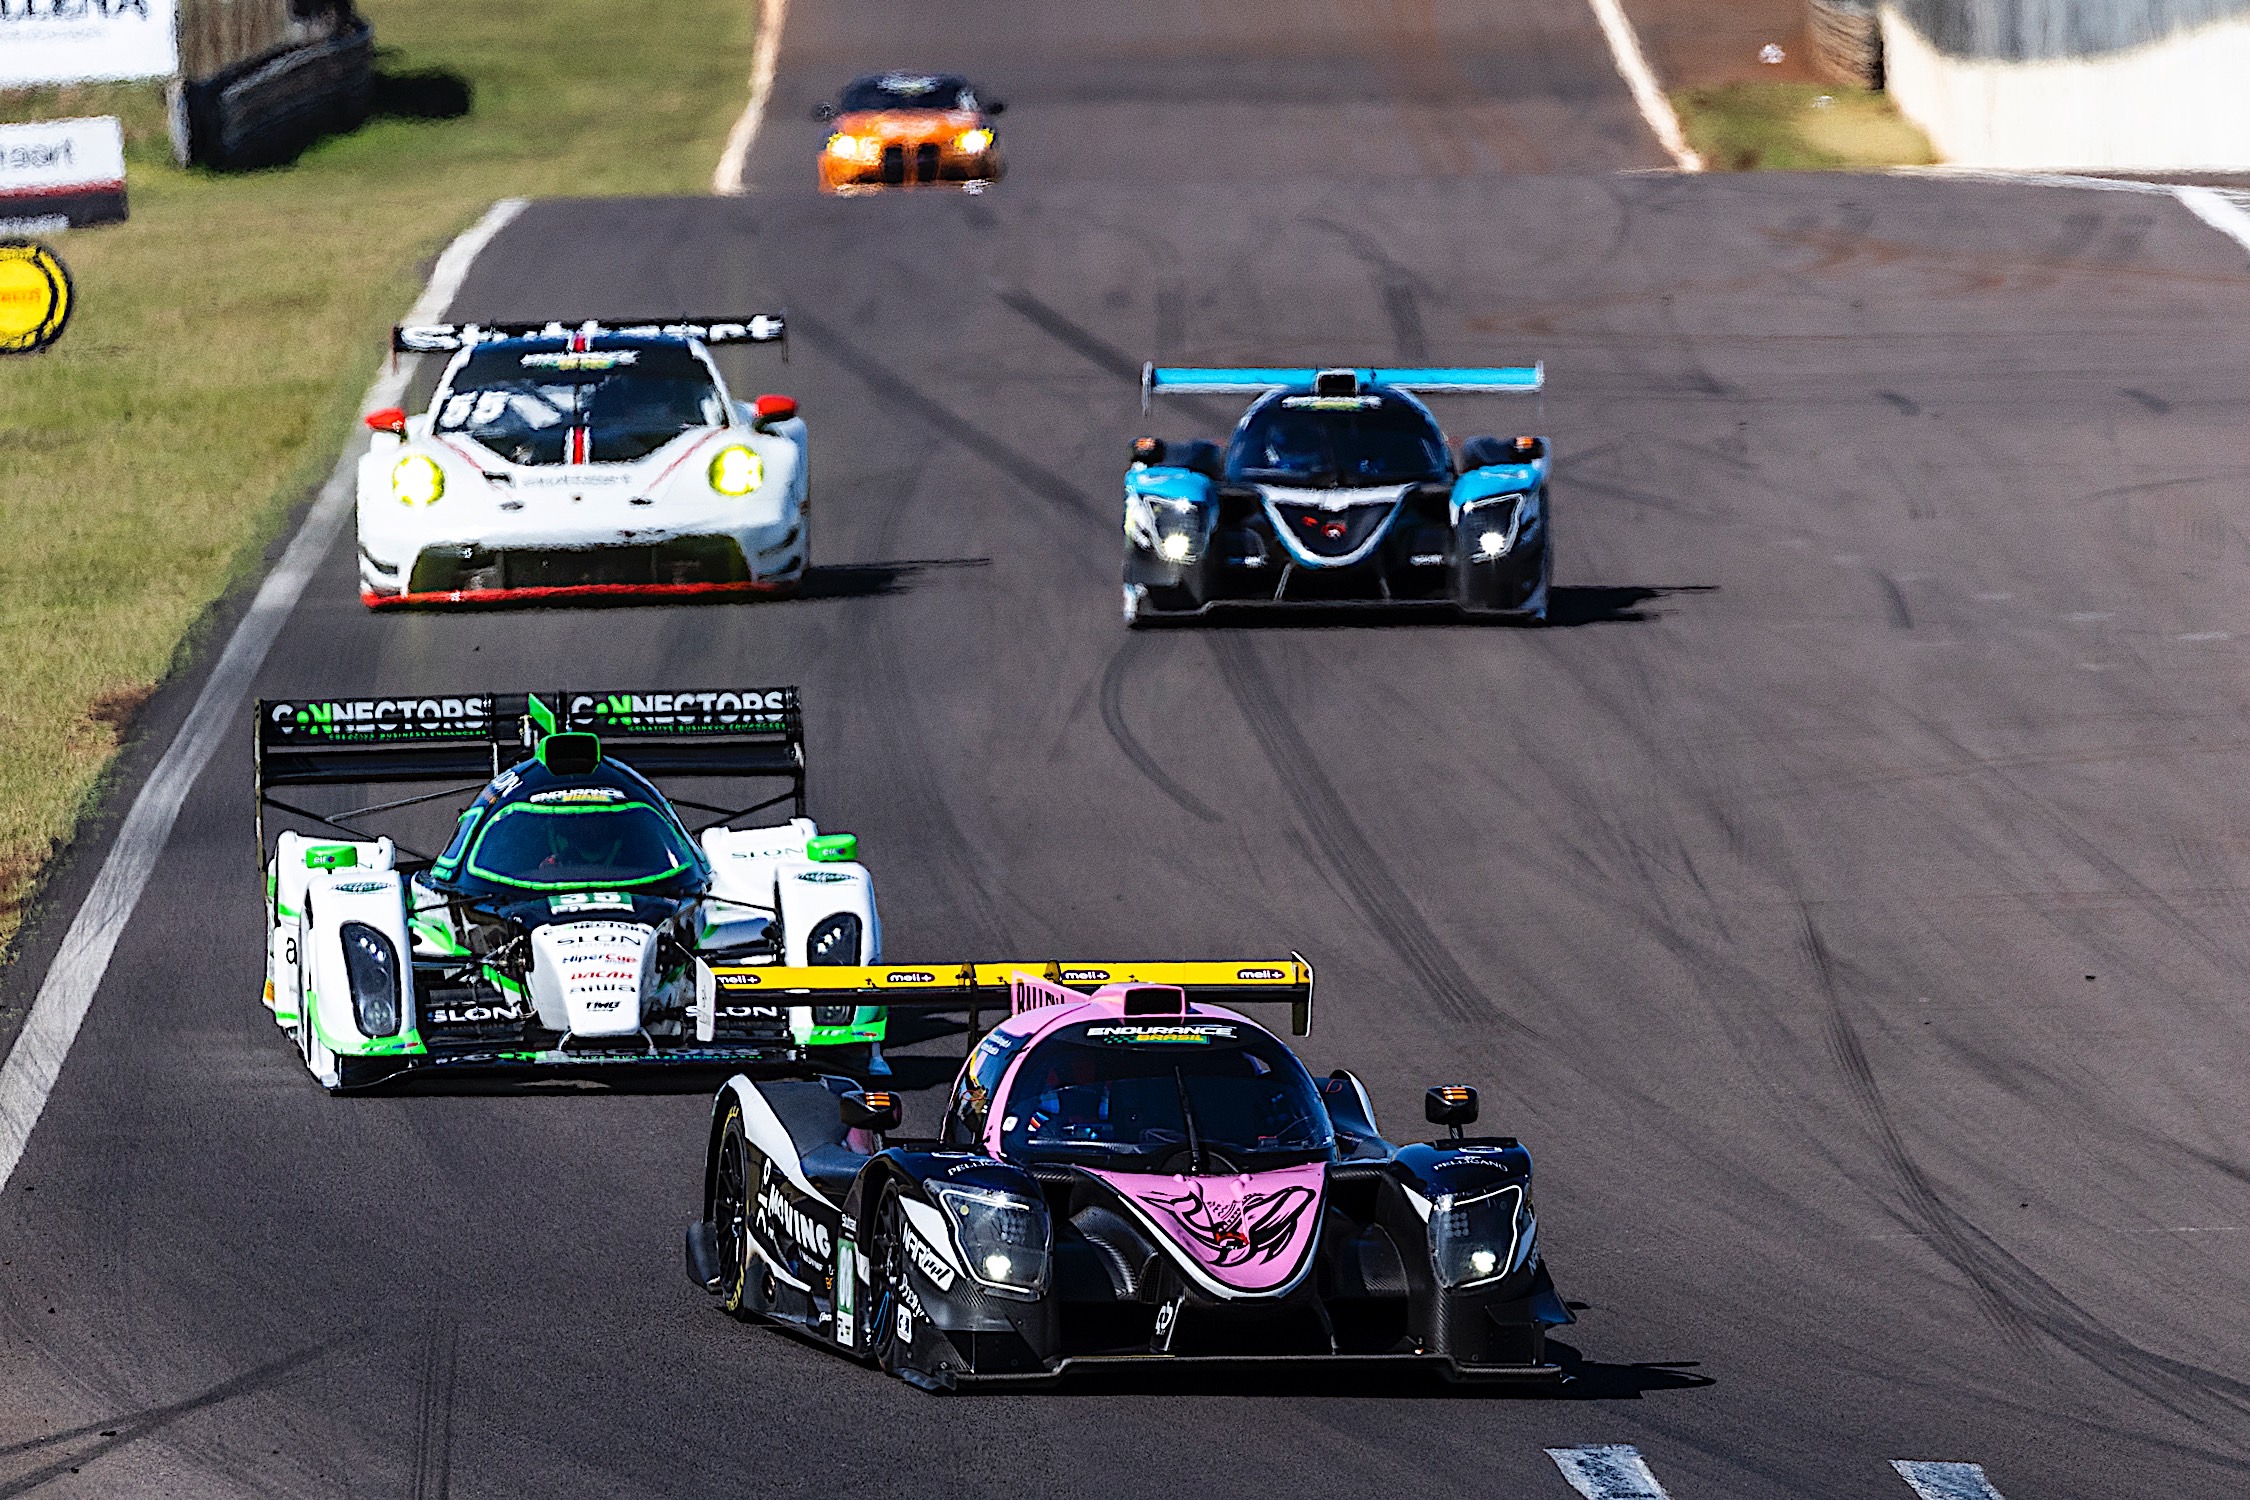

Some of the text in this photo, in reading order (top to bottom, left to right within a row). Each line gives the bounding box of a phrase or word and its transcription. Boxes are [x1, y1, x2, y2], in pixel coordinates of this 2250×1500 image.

[731, 847, 804, 859] SLON
[313, 856, 327, 865] elf
[543, 922, 651, 936] CNNECTORS
[556, 934, 641, 947] SLON
[889, 973, 932, 983] meli+
[1064, 971, 1108, 980] meli+
[1239, 969, 1283, 979] meli+
[433, 1006, 520, 1022] SLON
[1087, 1025, 1237, 1037] ENDURANCE
[1136, 1033, 1205, 1041] BRASIL
[767, 1183, 832, 1259] MOVING
